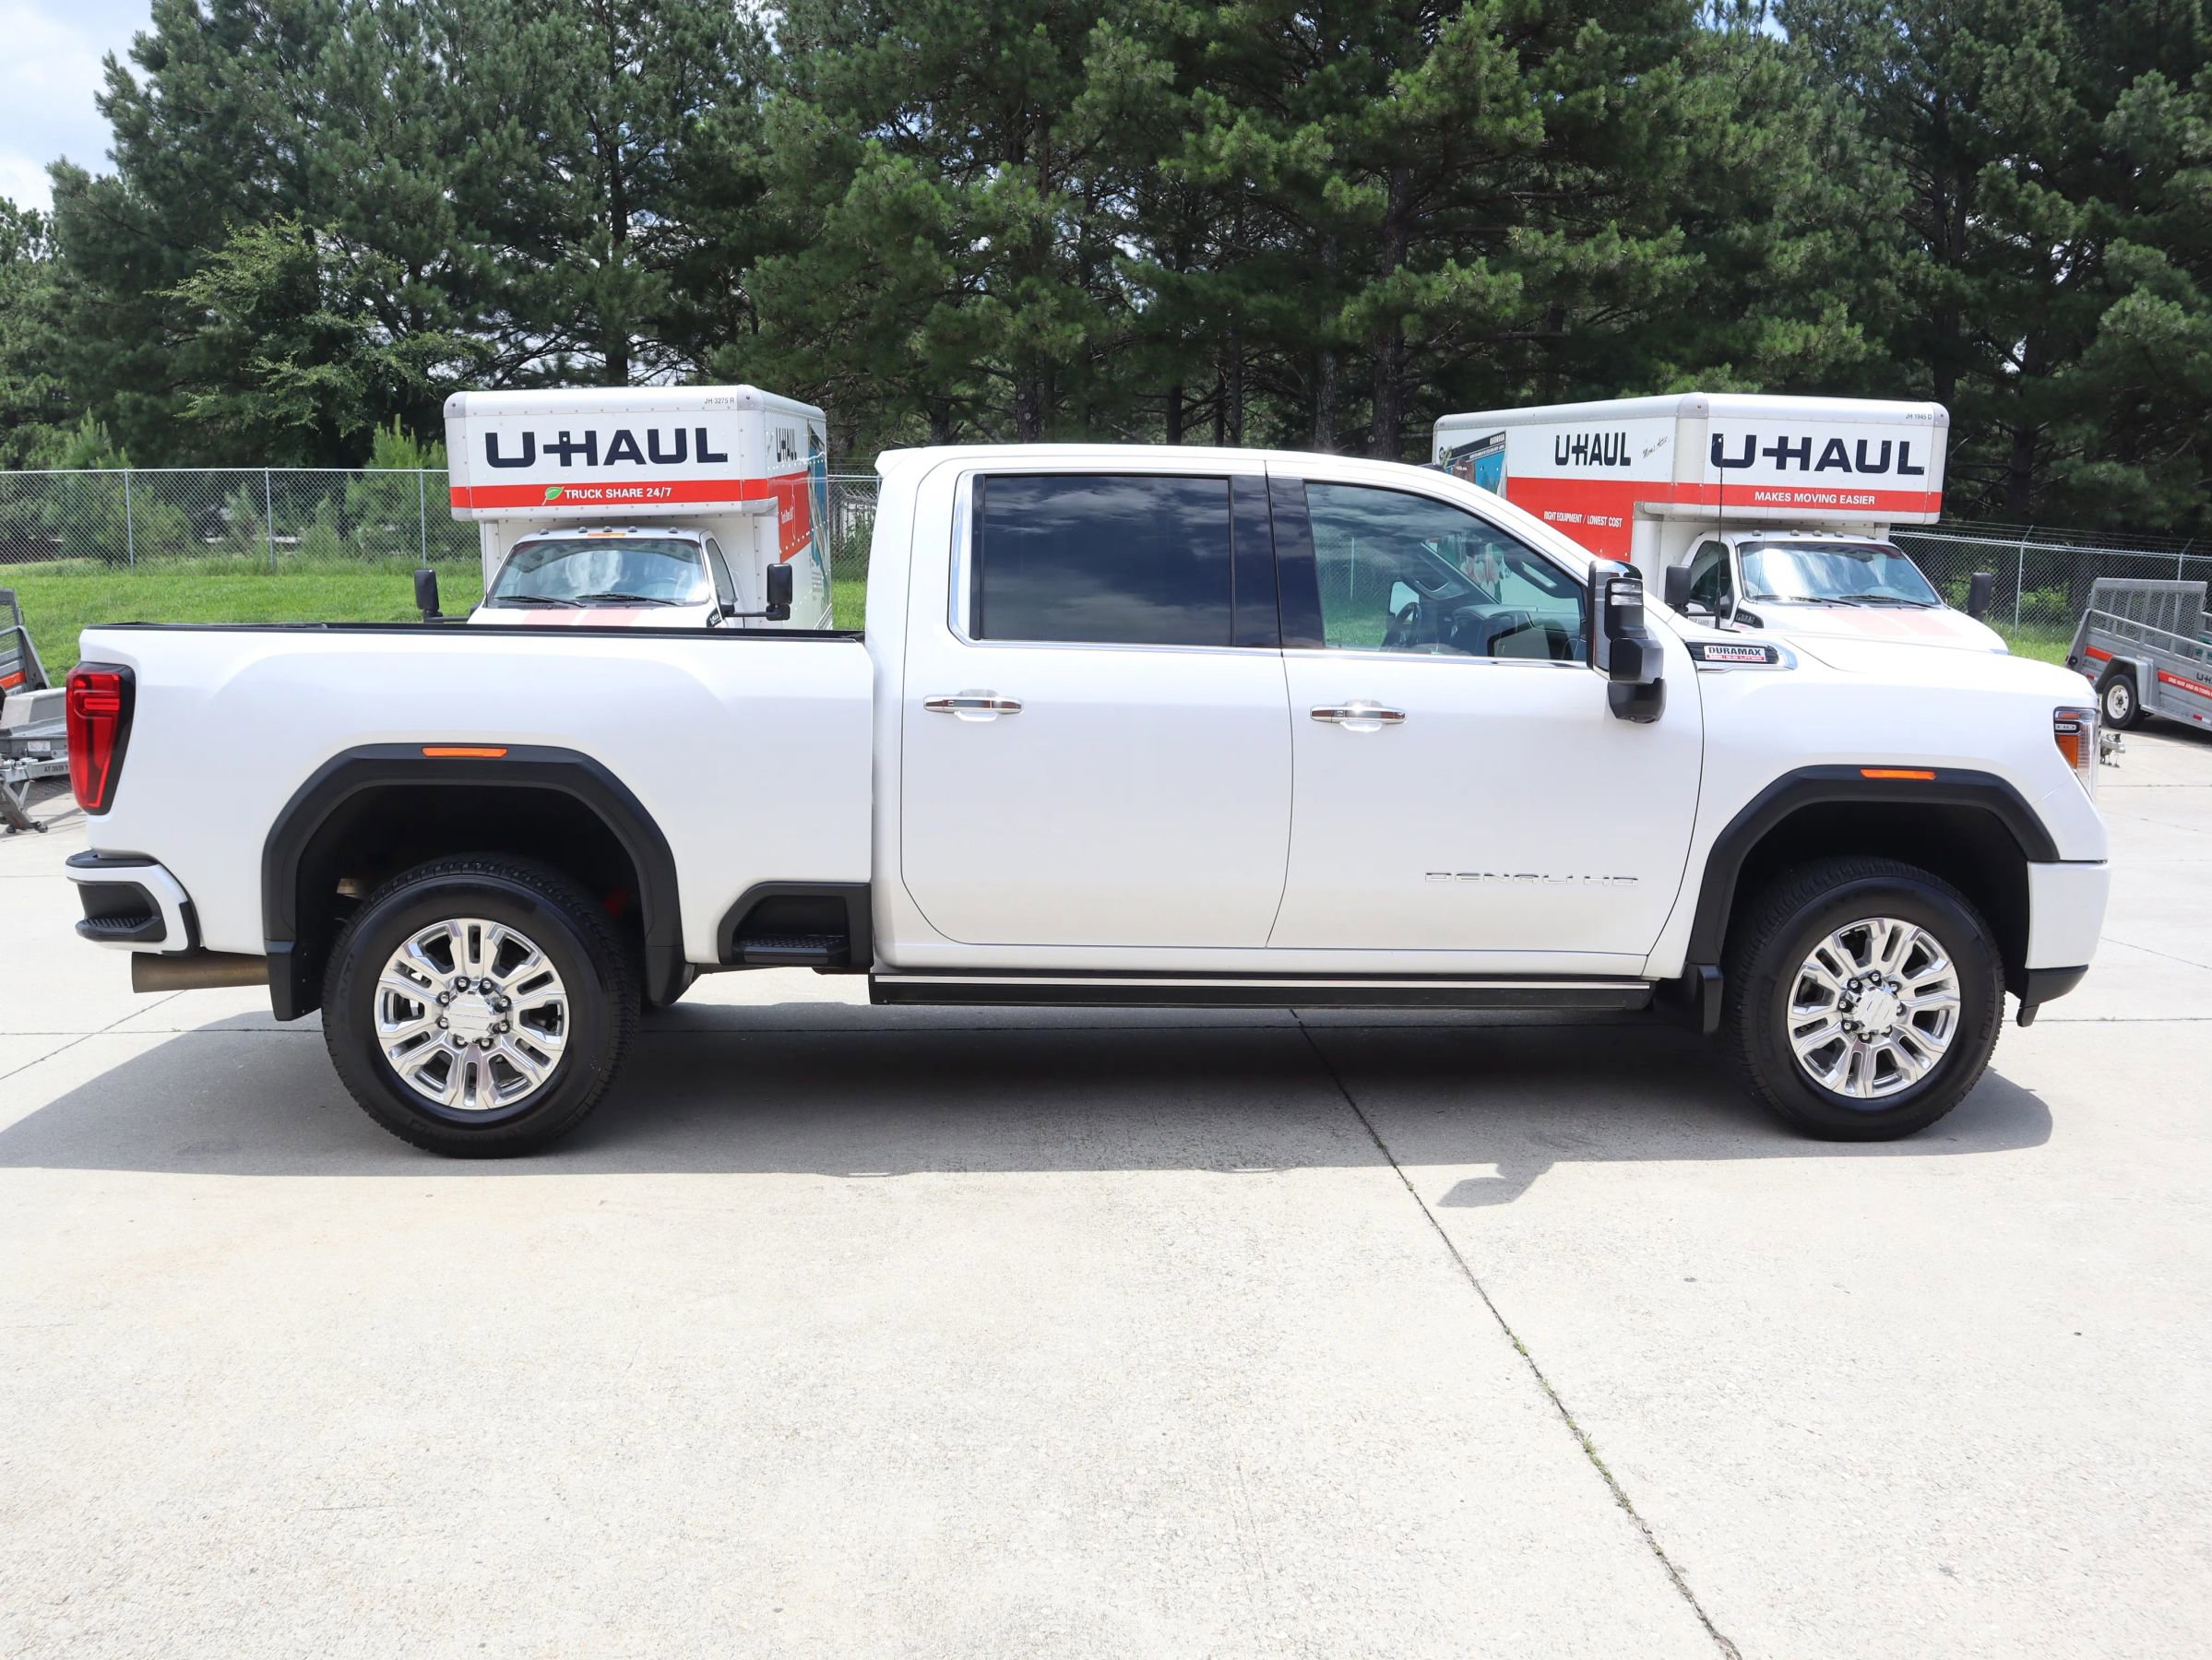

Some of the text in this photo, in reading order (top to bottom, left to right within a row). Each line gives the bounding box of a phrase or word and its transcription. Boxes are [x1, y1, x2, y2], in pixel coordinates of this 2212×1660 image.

[484, 427, 729, 468] U-HAUL
[1554, 432, 1632, 467] U-HAUL
[1710, 433, 1925, 476] U-HAUL
[565, 486, 672, 499] TRUCK SHARE 24/7
[1754, 491, 1875, 505] MAKES MOVING EASIER
[1543, 510, 1557, 521] RIGHT
[1557, 512, 1583, 524] EQUIPMENT
[1587, 515, 1608, 527] LOWEST
[1608, 516, 1623, 528] COST
[1708, 646, 1762, 656] DURAMAX
